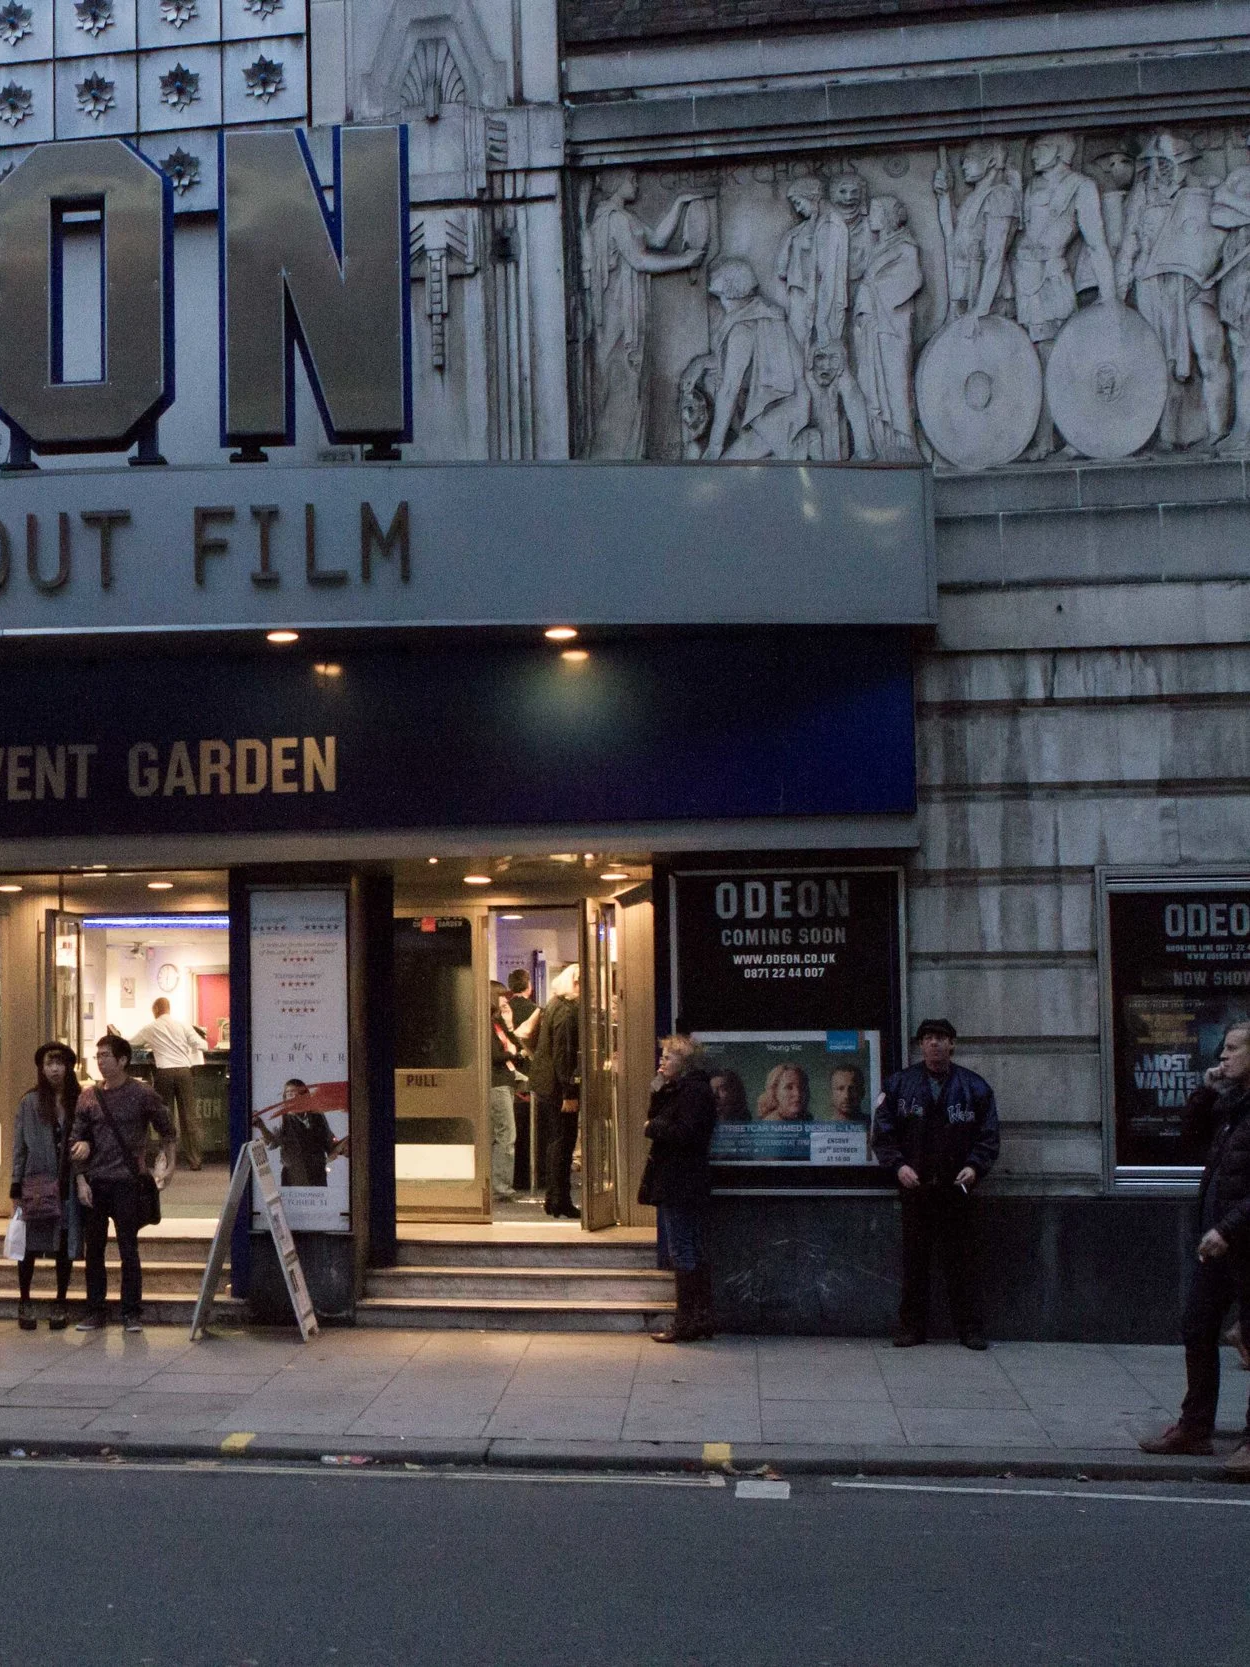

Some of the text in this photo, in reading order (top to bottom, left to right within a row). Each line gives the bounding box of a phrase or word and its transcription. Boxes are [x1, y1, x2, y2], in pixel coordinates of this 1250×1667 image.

[194, 501, 410, 586] FILM
[127, 736, 337, 796] GARDEN
[715, 880, 850, 919] ODEON
[721, 927, 847, 946] COMING SOON
[733, 953, 836, 965] WWW.ODEON.CO.UK
[744, 967, 825, 979] 0871 22 44 007
[1173, 971, 1207, 986] NOW
[254, 1053, 346, 1062] TURNER
[1143, 1053, 1192, 1071] MOST
[406, 1074, 438, 1088] PULL
[1157, 1089, 1192, 1108] MA
[770, 1124, 803, 1132] NAMED
